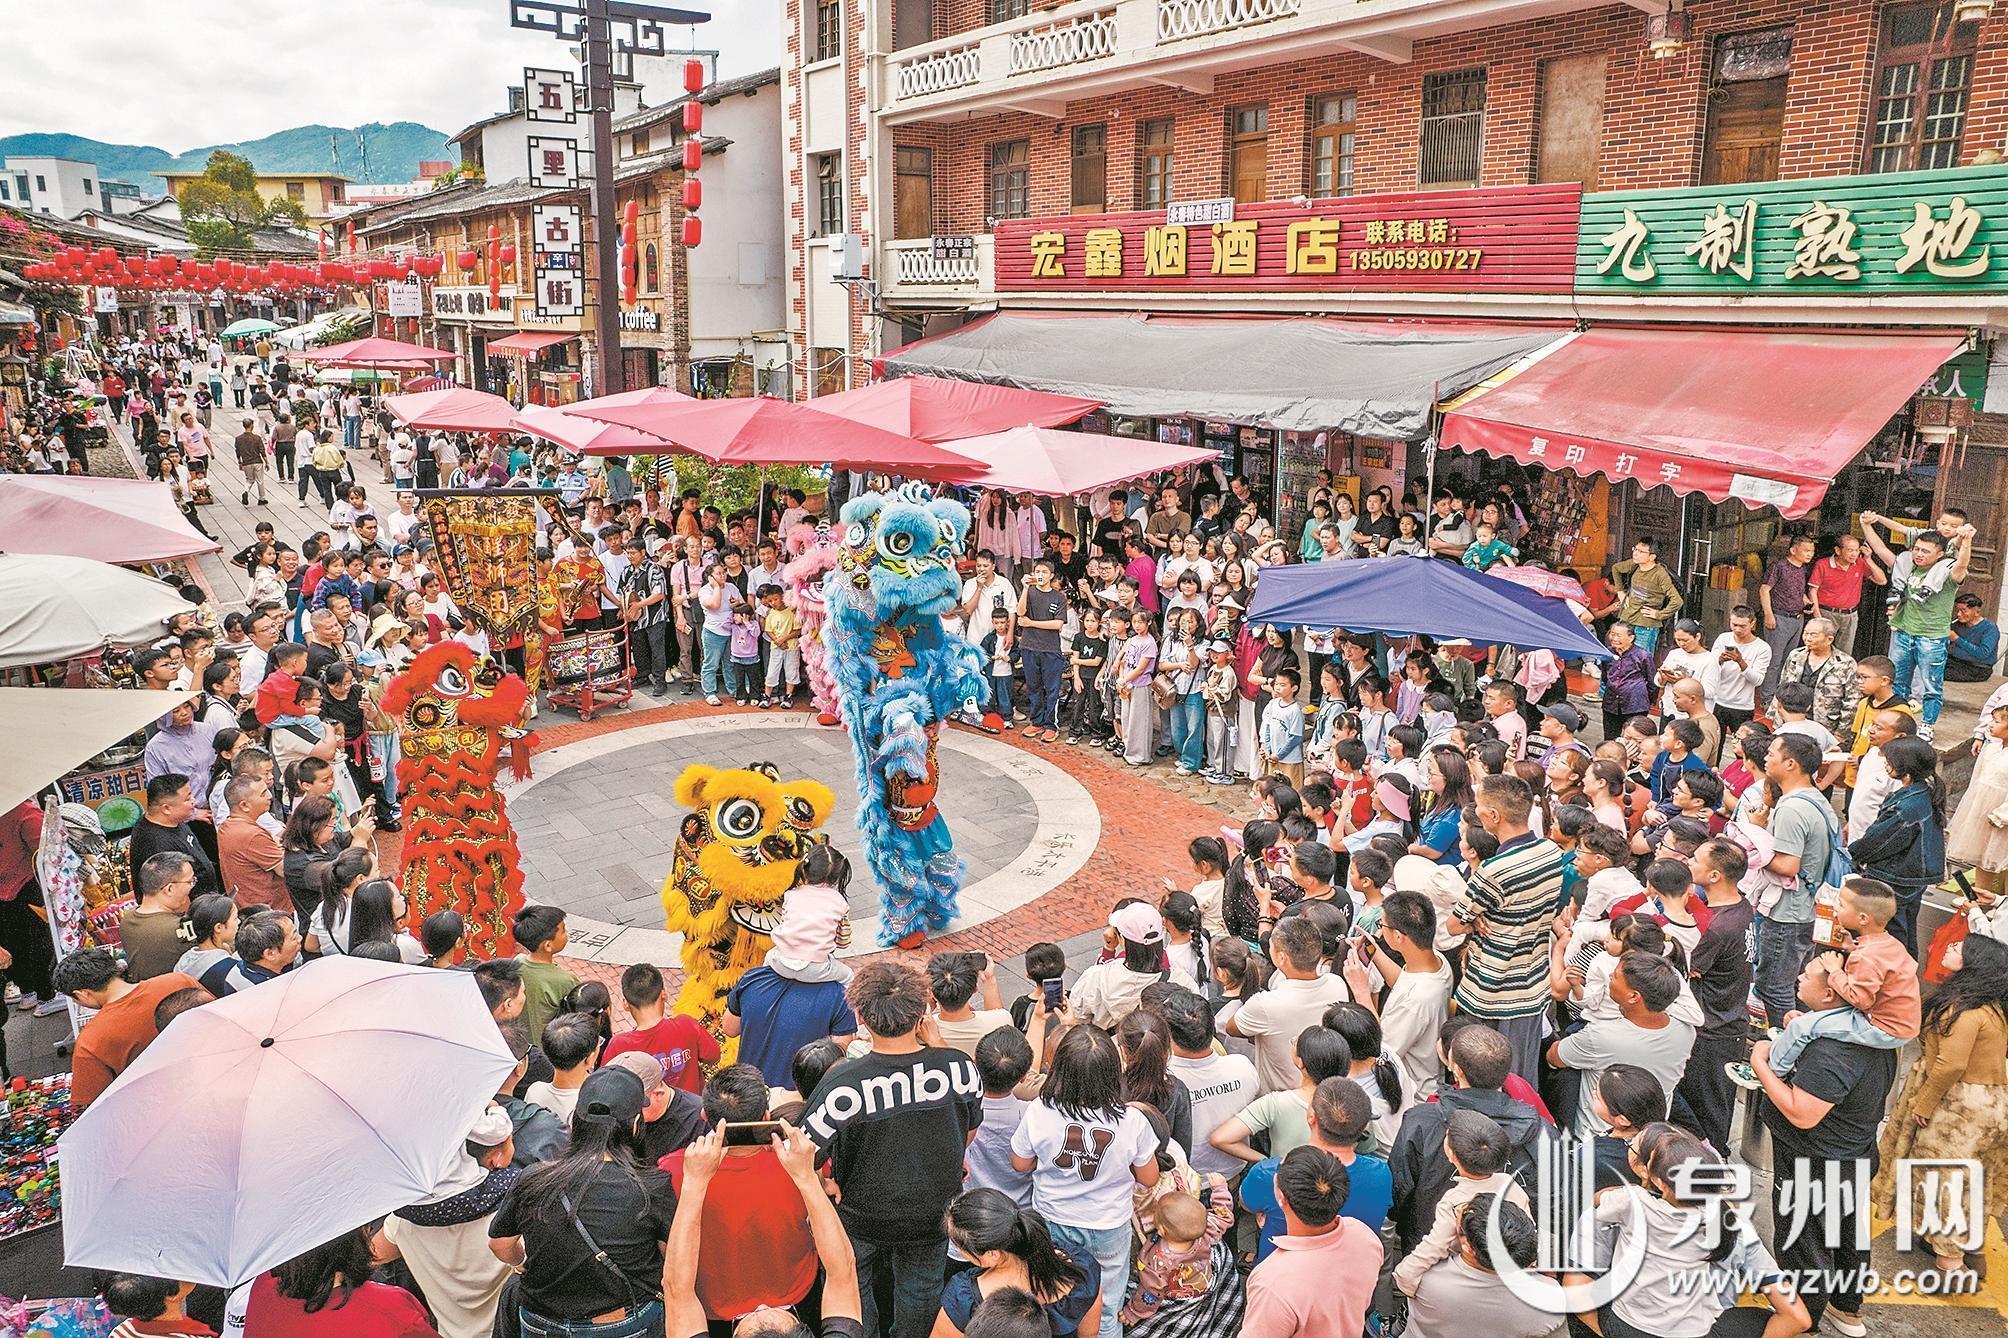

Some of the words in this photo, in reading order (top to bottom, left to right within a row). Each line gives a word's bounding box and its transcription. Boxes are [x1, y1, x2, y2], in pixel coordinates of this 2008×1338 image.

[537, 82, 573, 306] 五里古街
[1030, 217, 1341, 277] 宏鑫烟酒店
[1349, 249, 1482, 272] 13505930727
[1597, 196, 1989, 282] 九制熟地
[625, 305, 657, 330] coffee
[1528, 436, 1682, 482] 复印打字
[65, 770, 148, 804] 清凉甜白
